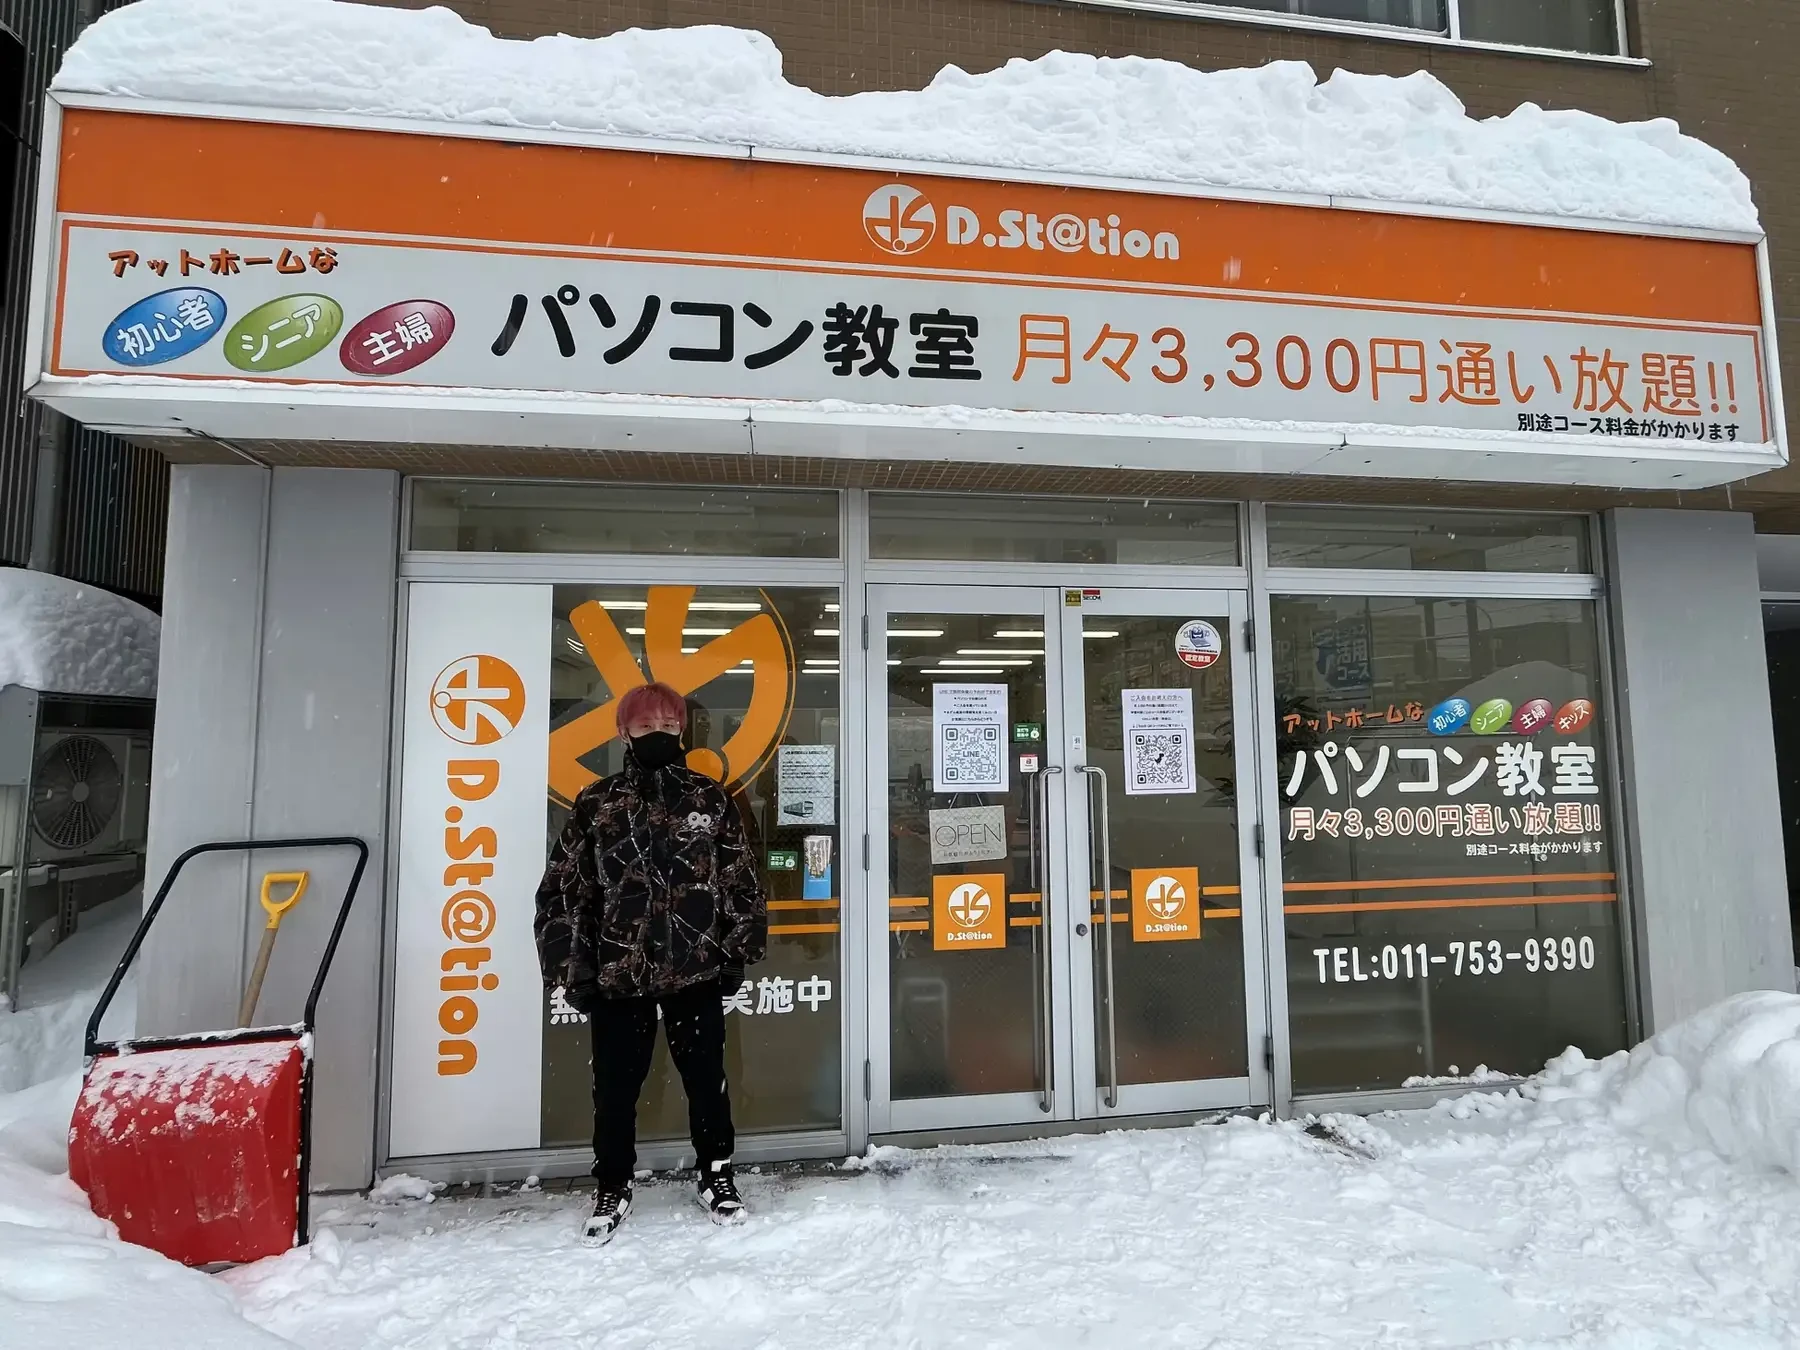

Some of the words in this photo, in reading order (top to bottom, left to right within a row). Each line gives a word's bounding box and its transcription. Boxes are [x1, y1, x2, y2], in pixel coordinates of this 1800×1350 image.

[946, 204, 1180, 261] D.St@tion
[107, 245, 340, 278] アットホームな
[115, 294, 218, 361] 初心者
[239, 302, 323, 364] シニア
[361, 310, 435, 368] 主婦
[490, 283, 983, 381] パソコン教室
[1517, 412, 1740, 442] 別途コース料金がかかります
[1282, 701, 1425, 734] アットホームな
[1431, 702, 1467, 732] 初心者
[1475, 703, 1509, 731] シニア
[1518, 703, 1547, 731] 主婦
[1557, 703, 1591, 731] キッズ
[962, 750, 980, 758] LINE
[1285, 741, 1600, 798] パソコン教室
[935, 822, 1002, 847] OPEN
[1465, 840, 1604, 857] 別途コース料金がかかります
[437, 758, 501, 1077] D.St@tion
[1145, 923, 1188, 933] D.St@tion
[947, 931, 993, 942] D.St@tion
